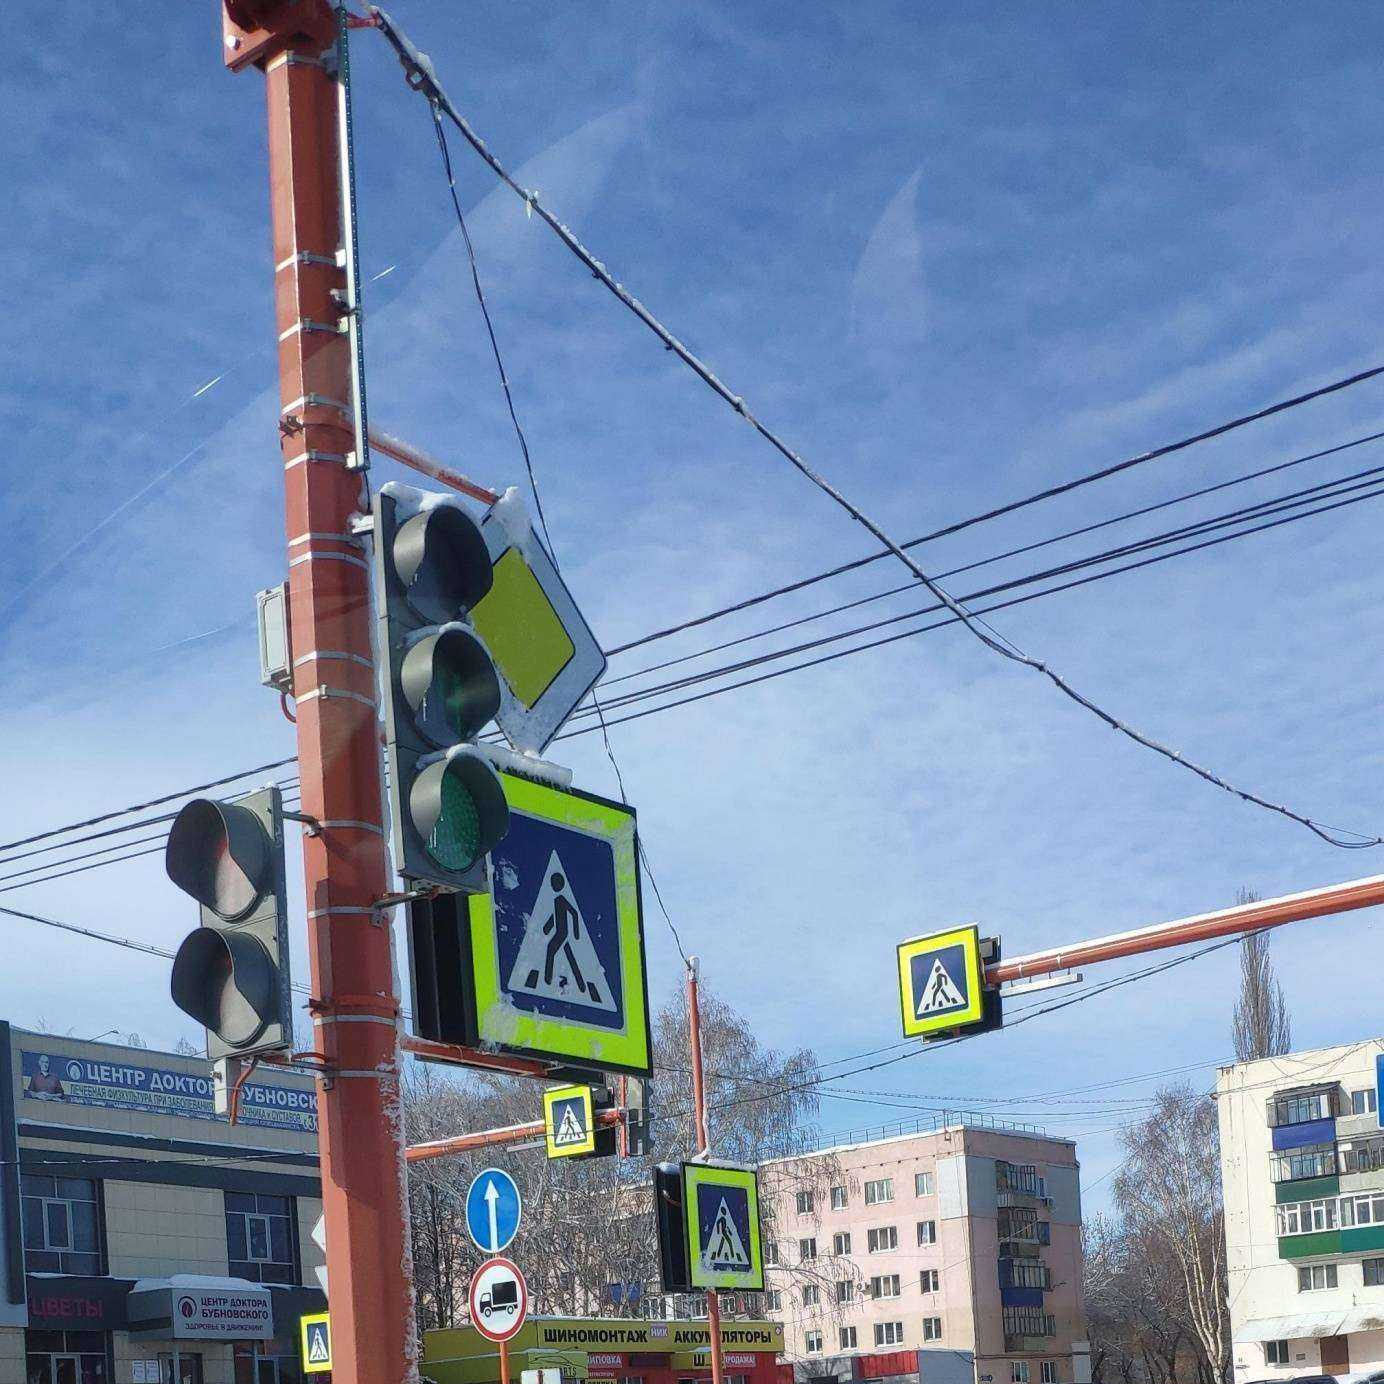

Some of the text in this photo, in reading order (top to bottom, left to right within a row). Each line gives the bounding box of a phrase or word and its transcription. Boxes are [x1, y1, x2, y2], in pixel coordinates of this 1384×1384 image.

[87, 1063, 146, 1086] ЦЕНТР
[241, 1085, 318, 1110] УБНОВСК
[31, 1296, 103, 1318] ЦВЕТЫ
[200, 1297, 268, 1308] ЦЕНТР ДОКТОРА
[201, 1308, 269, 1320] БУБНОВСКОГО
[185, 1322, 220, 1331] ЗДОРОВЬЕ
[544, 1328, 648, 1343] ШИНОМОНТАЖ
[674, 1330, 772, 1344] АККУМЛЯТОРЫ
